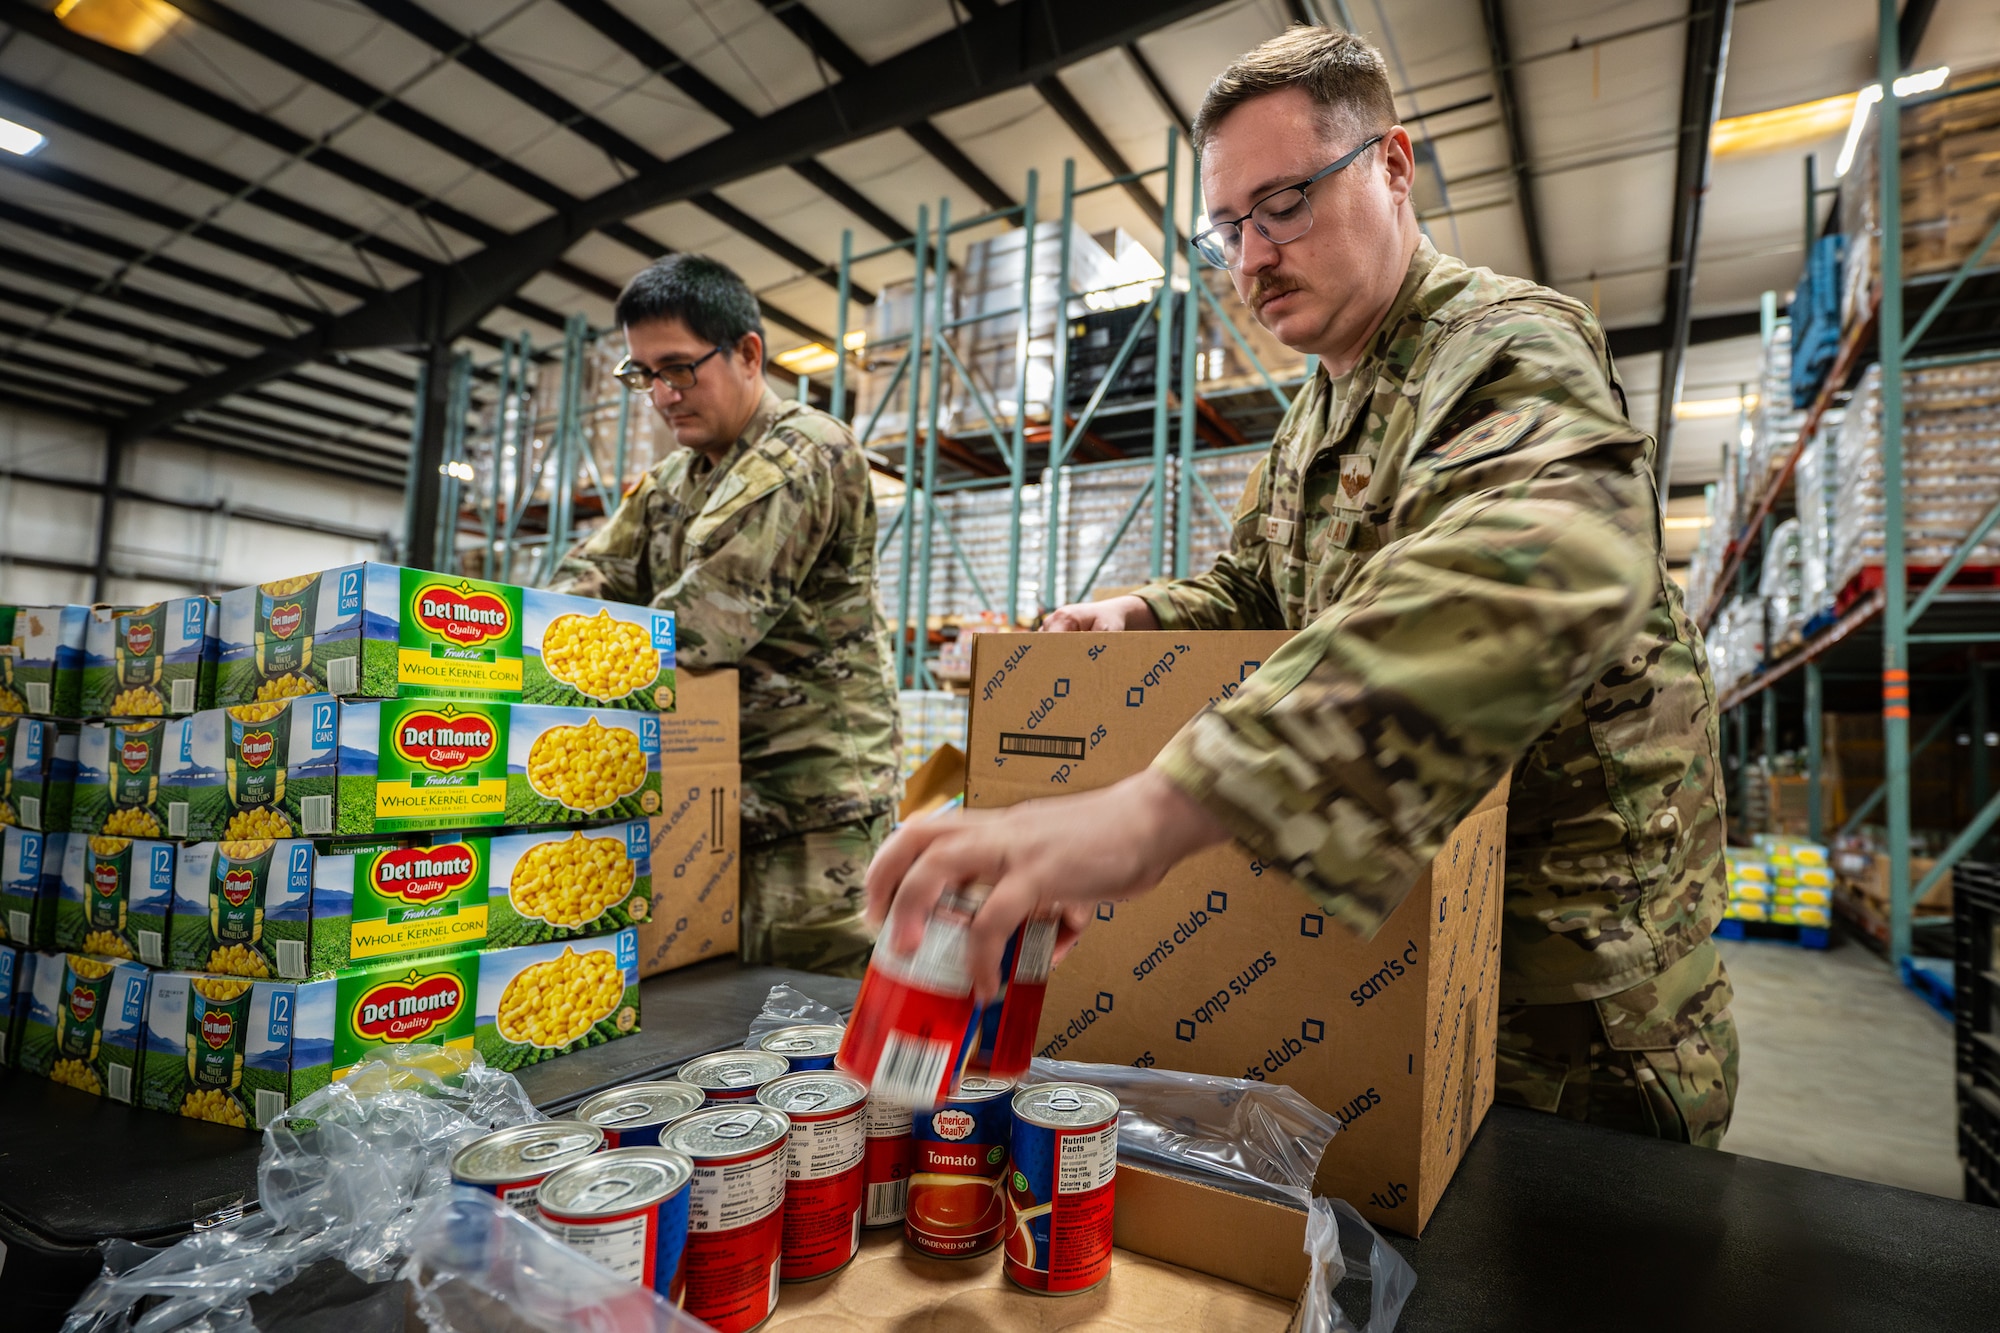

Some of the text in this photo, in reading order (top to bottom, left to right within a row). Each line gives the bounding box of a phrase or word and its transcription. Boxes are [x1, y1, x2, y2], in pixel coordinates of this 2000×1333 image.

[343, 573, 358, 596] 12
[187, 602, 200, 622] 12
[342, 597, 358, 610] CANS
[423, 599, 505, 626] Del Monte
[448, 622, 481, 638] Quality
[656, 617, 670, 636] 12
[655, 636, 672, 647] CANS
[404, 663, 519, 682] WHOLE KERNEL CORN
[1143, 652, 1176, 687] club
[317, 706, 332, 730] 12
[1026, 697, 1056, 730] club
[316, 731, 333, 743] CANS
[404, 727, 490, 747] Del Monte
[643, 719, 658, 738] 12
[430, 748, 465, 762] Quality
[382, 793, 502, 808] WHOLE KERNEL CORN
[630, 824, 647, 844] 12
[24, 838, 38, 858] 12
[332, 846, 374, 856] Nutrition
[154, 850, 170, 872] 12
[293, 848, 308, 874] 12
[380, 856, 471, 882] Del Monte
[154, 874, 171, 884] CANS
[292, 876, 308, 887] CANS
[406, 880, 444, 894] Quality
[355, 920, 484, 948] WHOLE KERNEL CORN
[620, 932, 636, 952] 12
[1133, 910, 1209, 981] sam's club
[128, 980, 141, 1004] 12
[1194, 951, 1277, 1024] sam's club
[1350, 960, 1405, 1007] sam's
[274, 996, 288, 1022] 12
[363, 990, 458, 1025] Del Monte
[272, 1024, 288, 1037] CANS
[390, 1017, 430, 1033] Quality
[1066, 1009, 1098, 1040] club
[1263, 1038, 1303, 1074] club
[938, 1114, 970, 1126] American
[1062, 1136, 1096, 1144] Nutrition
[1062, 1145, 1084, 1153] Facts
[928, 1150, 977, 1166] Tomato
[790, 1170, 800, 1178] 90
[1082, 1181, 1091, 1190] 90
[696, 1221, 708, 1230] 90
[918, 1236, 977, 1250] CONDENSED SOUP
